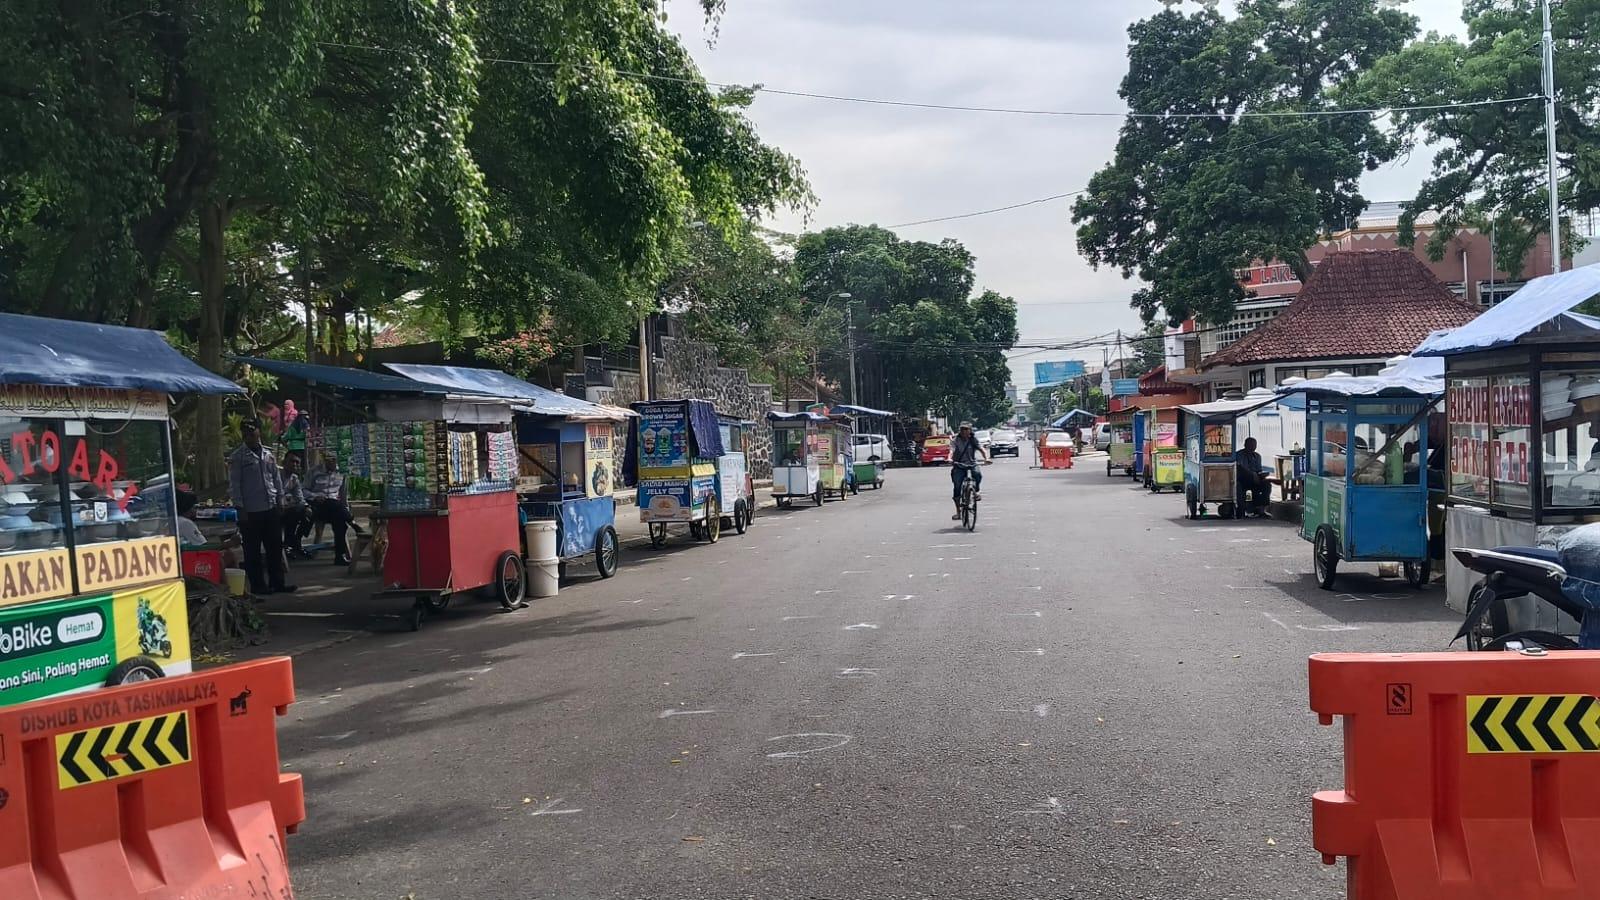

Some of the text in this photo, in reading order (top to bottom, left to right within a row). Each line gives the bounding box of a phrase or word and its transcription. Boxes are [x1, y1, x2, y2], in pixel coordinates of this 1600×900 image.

[87, 387, 128, 413] PADANG
[1449, 384, 1531, 427] BUBUR AYAM
[1204, 444, 1232, 453] PADANG
[1450, 436, 1528, 485] JAKARTA
[640, 480, 663, 488] SALAD
[645, 487, 668, 495] JELLY
[2, 543, 173, 599] AKAN PADANG
[65, 620, 94, 636] Hemat
[22, 666, 44, 684] Sini,
[45, 661, 77, 678] Paling
[78, 653, 110, 671] Hemat
[20, 681, 219, 733] DISHUB KOTA TASIKMALAYA
